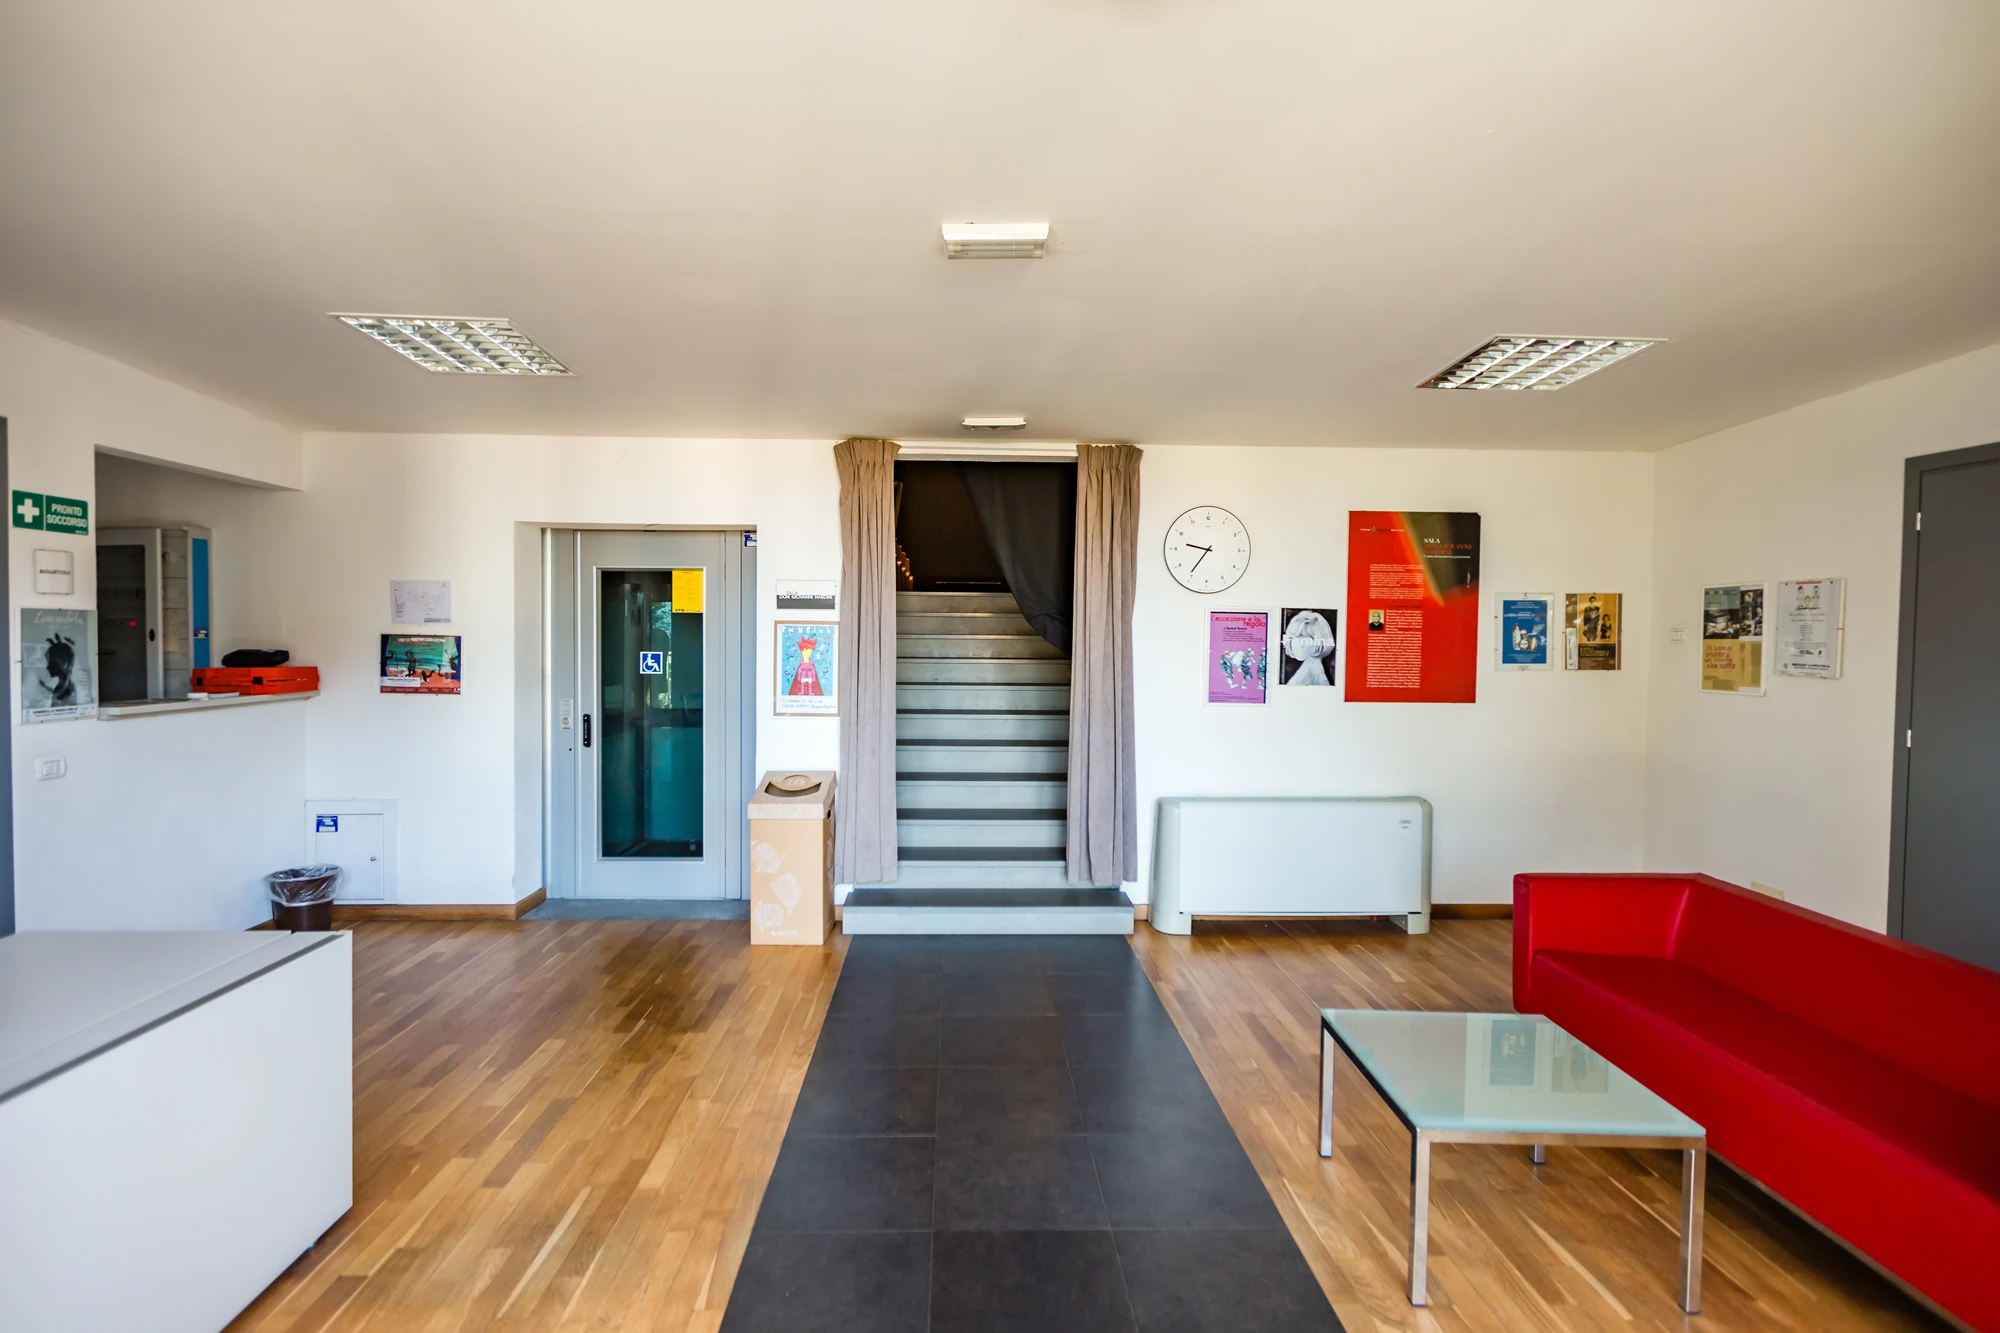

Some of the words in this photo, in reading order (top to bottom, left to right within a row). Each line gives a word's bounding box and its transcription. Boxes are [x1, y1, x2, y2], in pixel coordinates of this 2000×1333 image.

[51, 503, 83, 516] PRONTO
[46, 514, 87, 528] SOCCORSO
[1210, 614, 1247, 622] L'eccezione
[1243, 620, 1266, 629] regola
